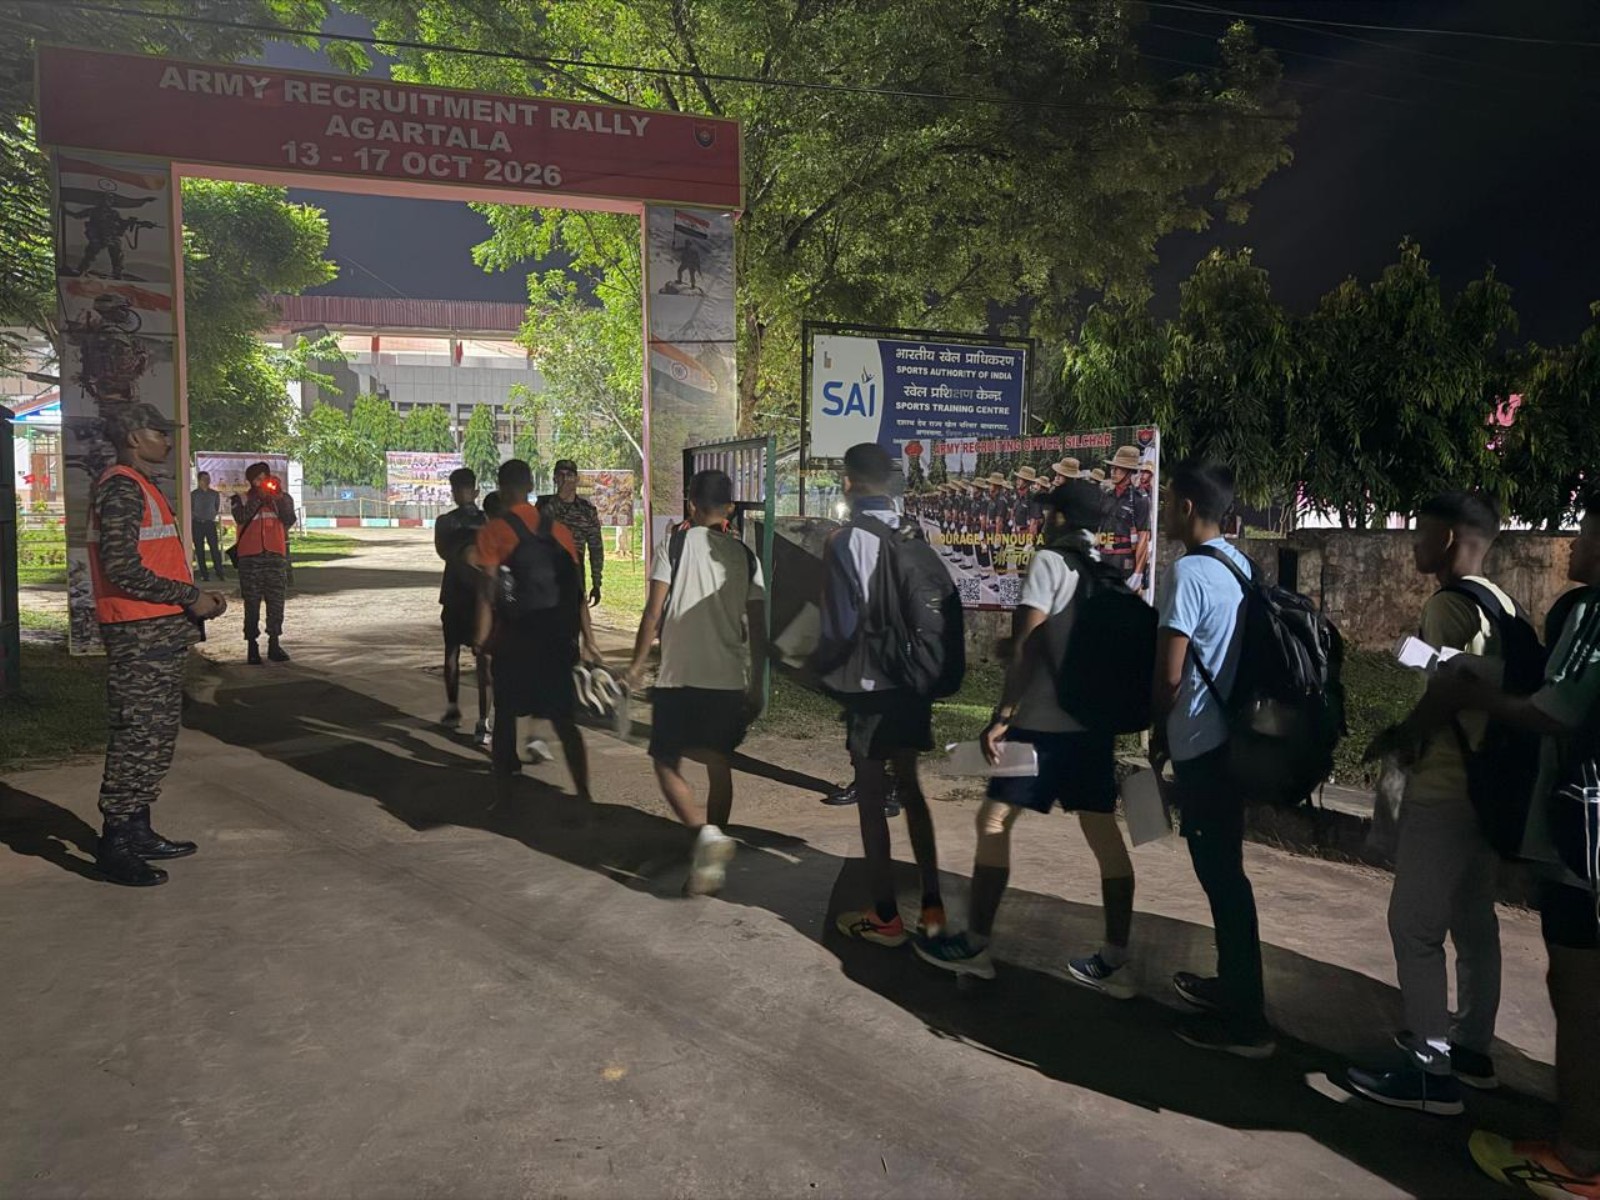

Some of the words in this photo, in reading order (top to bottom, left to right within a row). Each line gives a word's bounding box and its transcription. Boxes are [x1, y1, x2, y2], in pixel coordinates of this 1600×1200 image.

[159, 66, 270, 99] ARMY
[284, 79, 538, 126] RECRUITMENT
[551, 107, 650, 137] RALLY
[325, 115, 512, 152] AGARTALA
[281, 140, 321, 166] 13
[354, 146, 391, 171] 17
[402, 152, 472, 178] OCT
[484, 158, 562, 186] 2026
[895, 345, 935, 360] भारतीय
[939, 348, 960, 363] खेल
[966, 350, 1015, 366] प्राधिकरण
[896, 365, 928, 375] SPORTS
[930, 368, 976, 378] AUTHORITY
[978, 371, 988, 379] OF
[990, 371, 1012, 380] INDIA
[821, 381, 876, 417] SAI
[903, 382, 927, 398] खेल
[895, 402, 930, 411] SPORTS
[932, 404, 975, 413] TRAINING
[976, 406, 1010, 415] CENTRE
[934, 443, 960, 455] ARMY
[963, 439, 1021, 454] RECRUITING
[1064, 433, 1112, 448] SILCHAR
